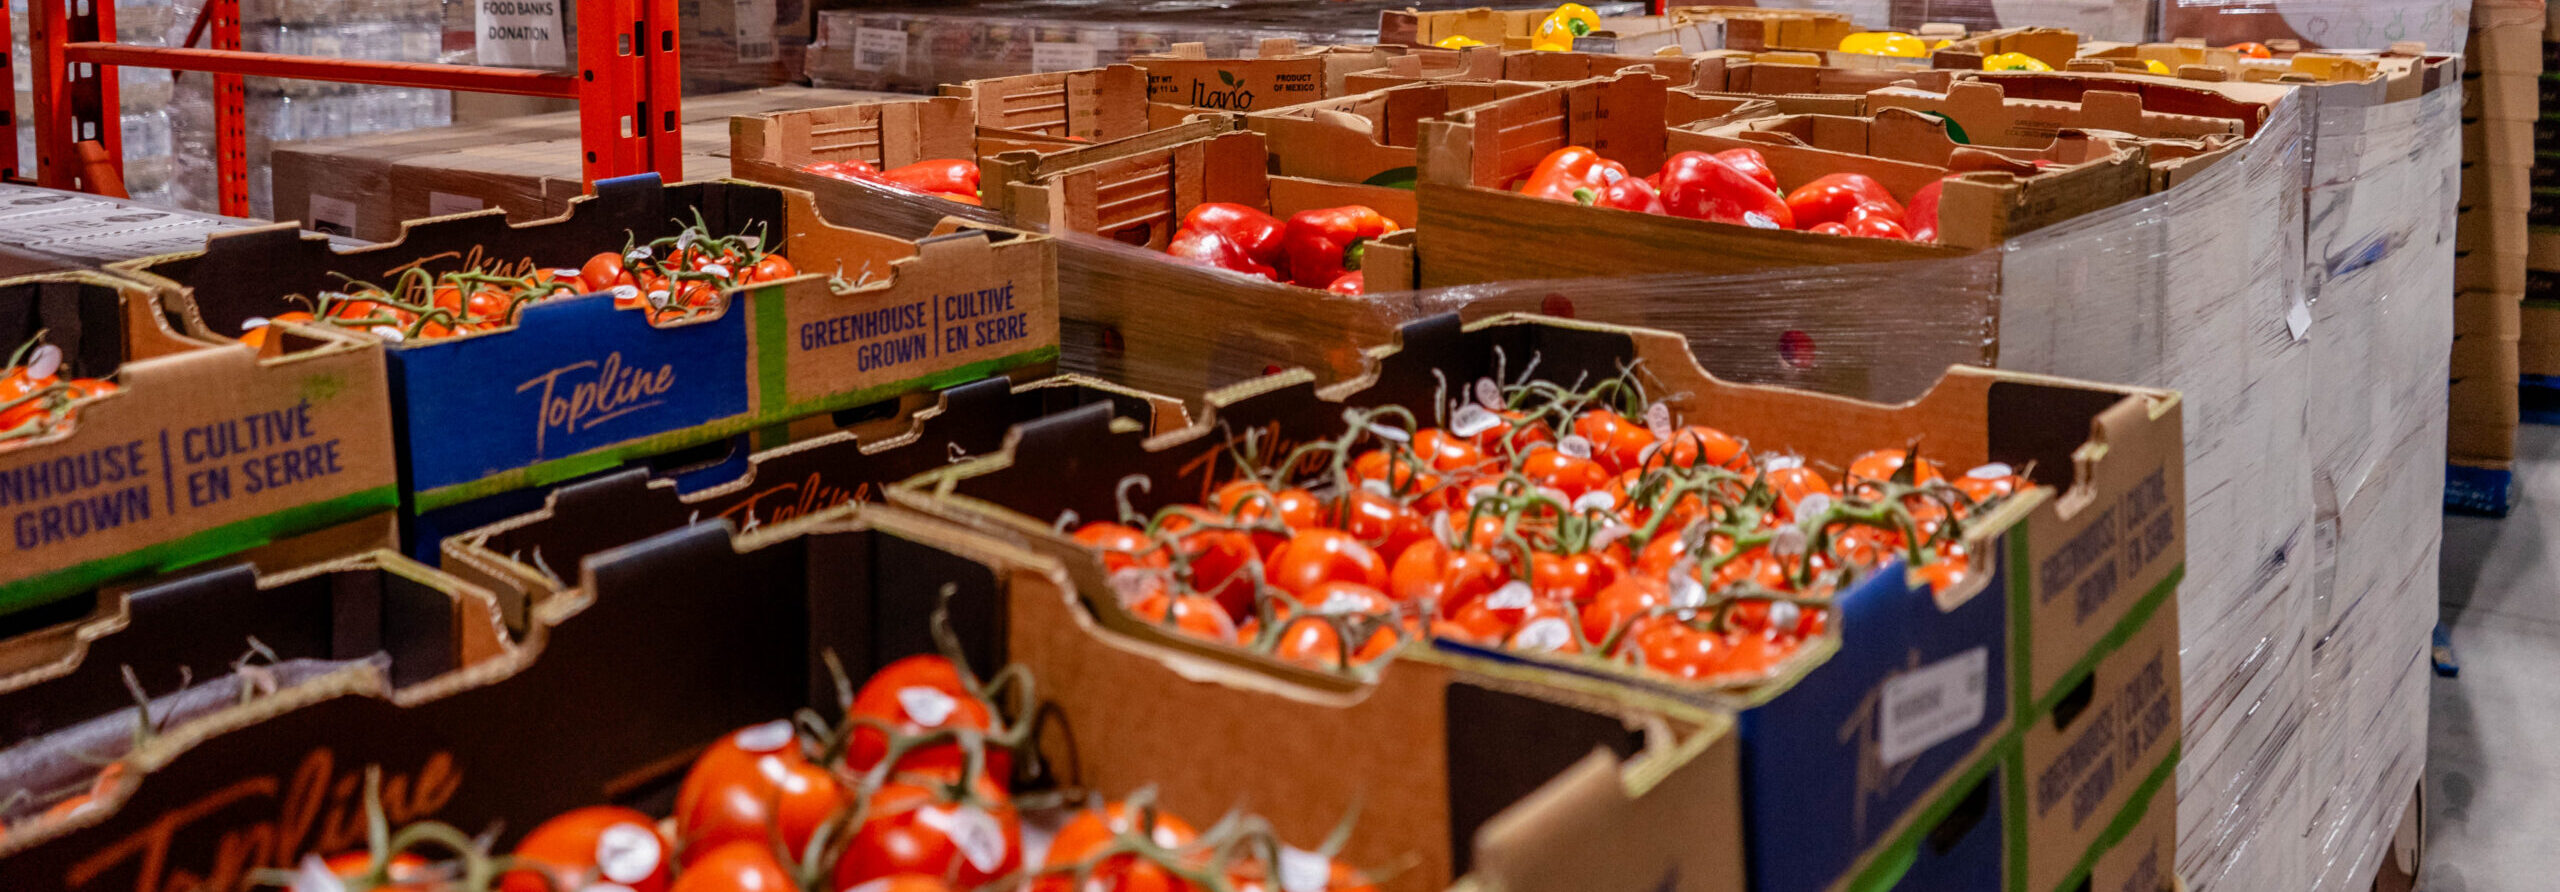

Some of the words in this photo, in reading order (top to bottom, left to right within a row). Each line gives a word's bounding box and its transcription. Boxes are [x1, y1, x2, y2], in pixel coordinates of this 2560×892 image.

[483, 2, 515, 15] FOOD
[517, 3, 554, 16] BANKS
[488, 26, 549, 41] DONATION
[1149, 75, 1160, 83] ET
[1273, 84, 1284, 92] OF
[1285, 83, 1315, 92] MEXICO
[1275, 74, 1312, 82] PRODUCT
[945, 280, 1015, 322] CULTIVÉ
[800, 302, 927, 351] GREENHOUSE
[946, 325, 968, 353] EN
[975, 312, 1028, 347] SERRE
[857, 333, 927, 373] GROWN
[516, 351, 676, 458] Topline
[182, 397, 315, 465] CULTIVÉ
[188, 466, 232, 508] EN
[242, 439, 345, 495] SERRE
[14, 485, 152, 551] GROWN
